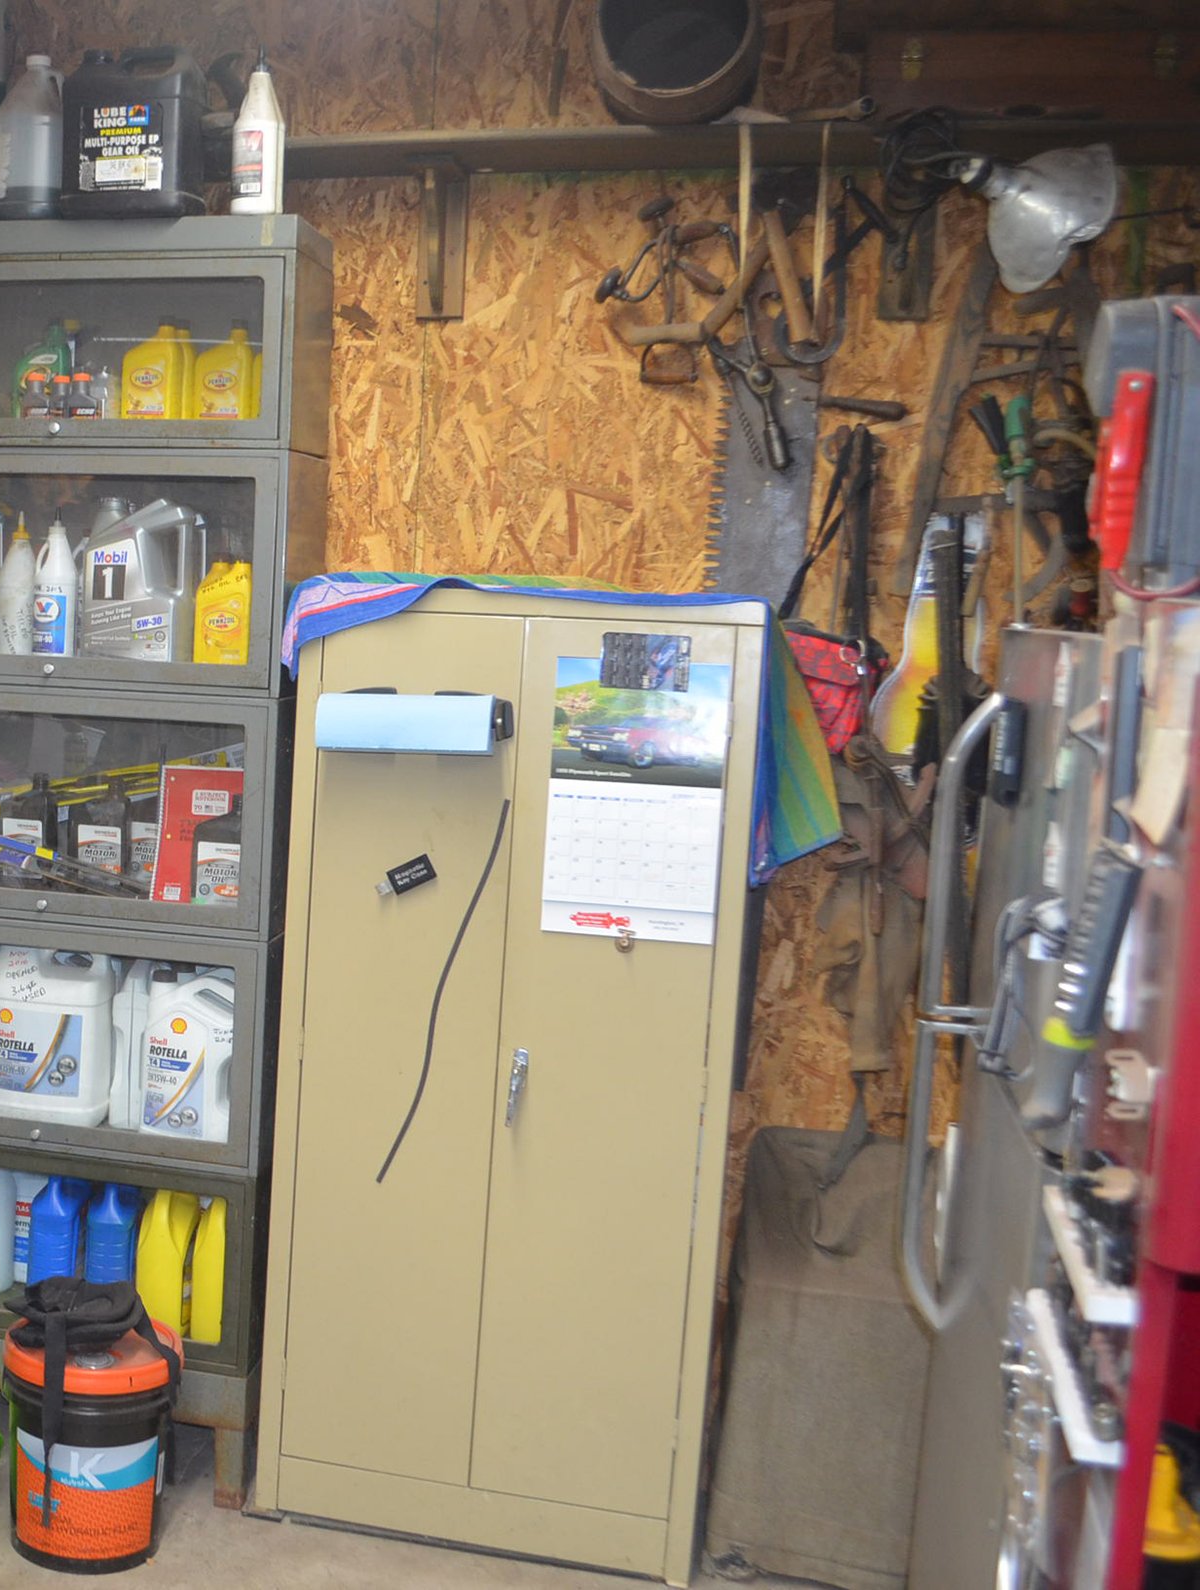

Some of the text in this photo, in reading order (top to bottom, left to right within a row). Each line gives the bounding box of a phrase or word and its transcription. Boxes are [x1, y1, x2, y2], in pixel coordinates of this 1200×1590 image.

[93, 106, 127, 118] LUBE
[93, 117, 127, 129] KING
[100, 127, 142, 136] PREMIUM
[84, 134, 160, 148] MULTI-PURPOSE EP
[102, 145, 139, 157] GEAR OIL
[94, 551, 128, 563] Mobil
[102, 567, 114, 599] 1
[136, 616, 163, 629] 5W-30
[84, 848, 117, 859] MOTOR
[204, 867, 238, 877] MOTOR
[211, 875, 226, 883] OIL
[149, 1036, 168, 1046] Shell
[149, 1045, 188, 1060] ROTELLA
[149, 1058, 158, 1067] T4
[69, 1450, 107, 1490] K
